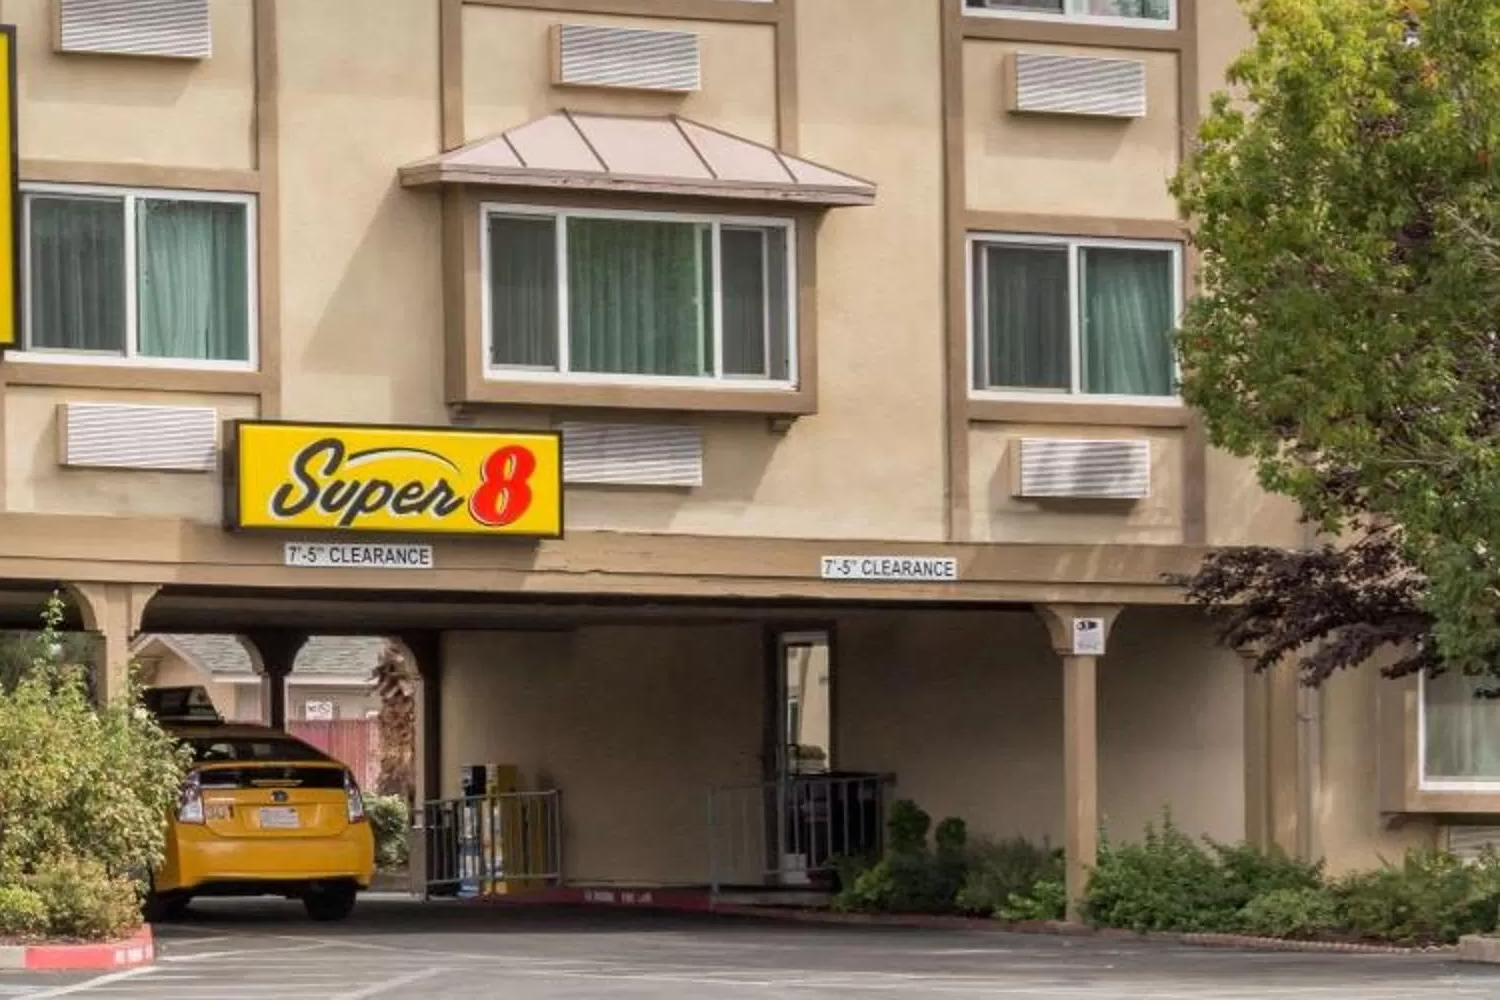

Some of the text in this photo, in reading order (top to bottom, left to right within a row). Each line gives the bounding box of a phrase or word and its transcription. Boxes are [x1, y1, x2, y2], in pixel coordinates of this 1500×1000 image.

[271, 437, 536, 528] Super 8
[329, 546, 430, 565] CLEARANCE
[861, 559, 954, 577] CLEARANCE
